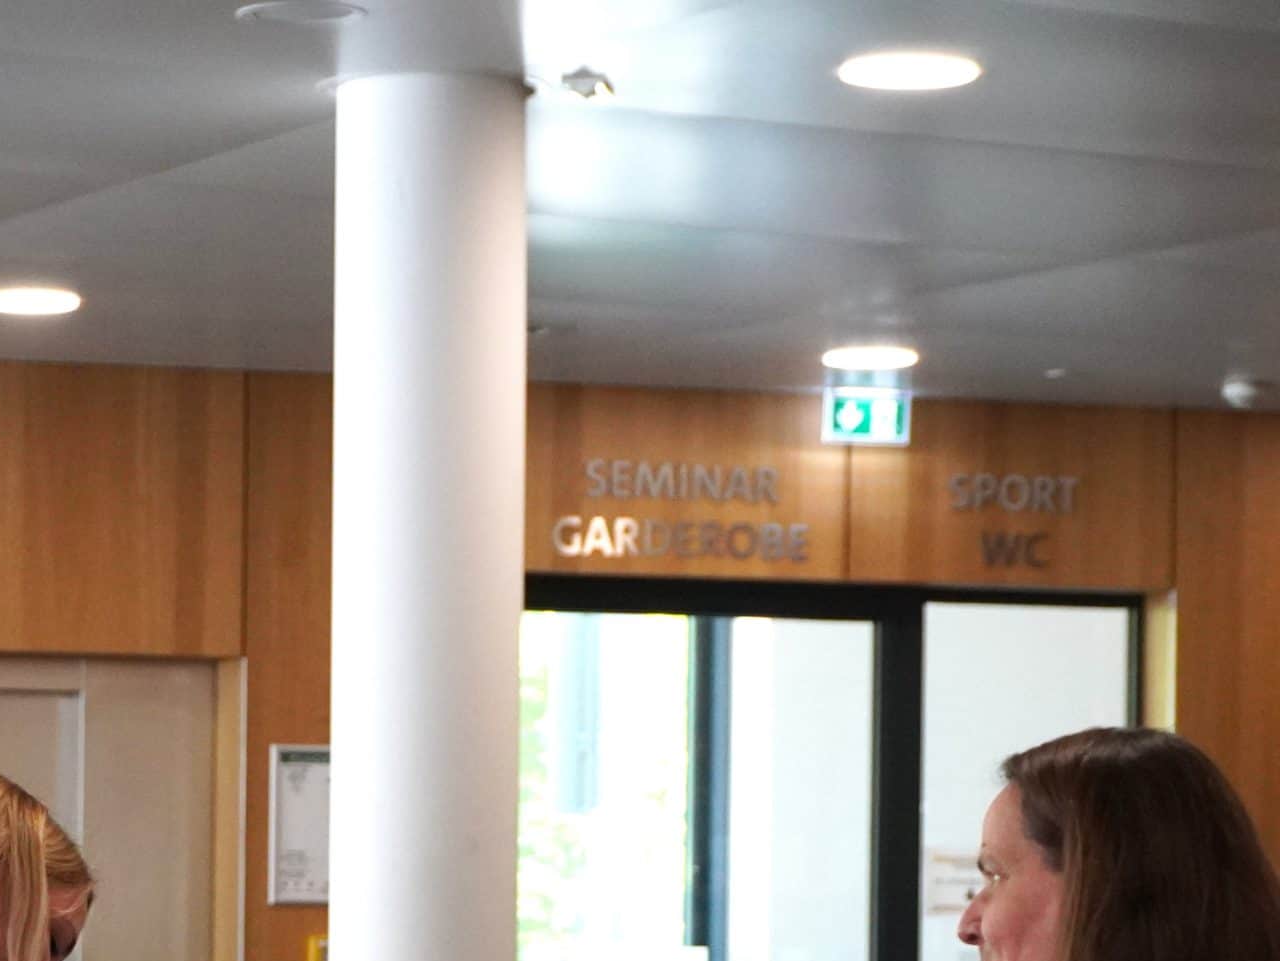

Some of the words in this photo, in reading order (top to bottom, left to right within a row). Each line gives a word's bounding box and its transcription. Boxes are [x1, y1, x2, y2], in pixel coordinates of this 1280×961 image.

[586, 458, 779, 503] SEMINAR
[950, 472, 1079, 513] SPORT
[553, 515, 810, 563] GARDEROBE
[981, 531, 1049, 568] WC
